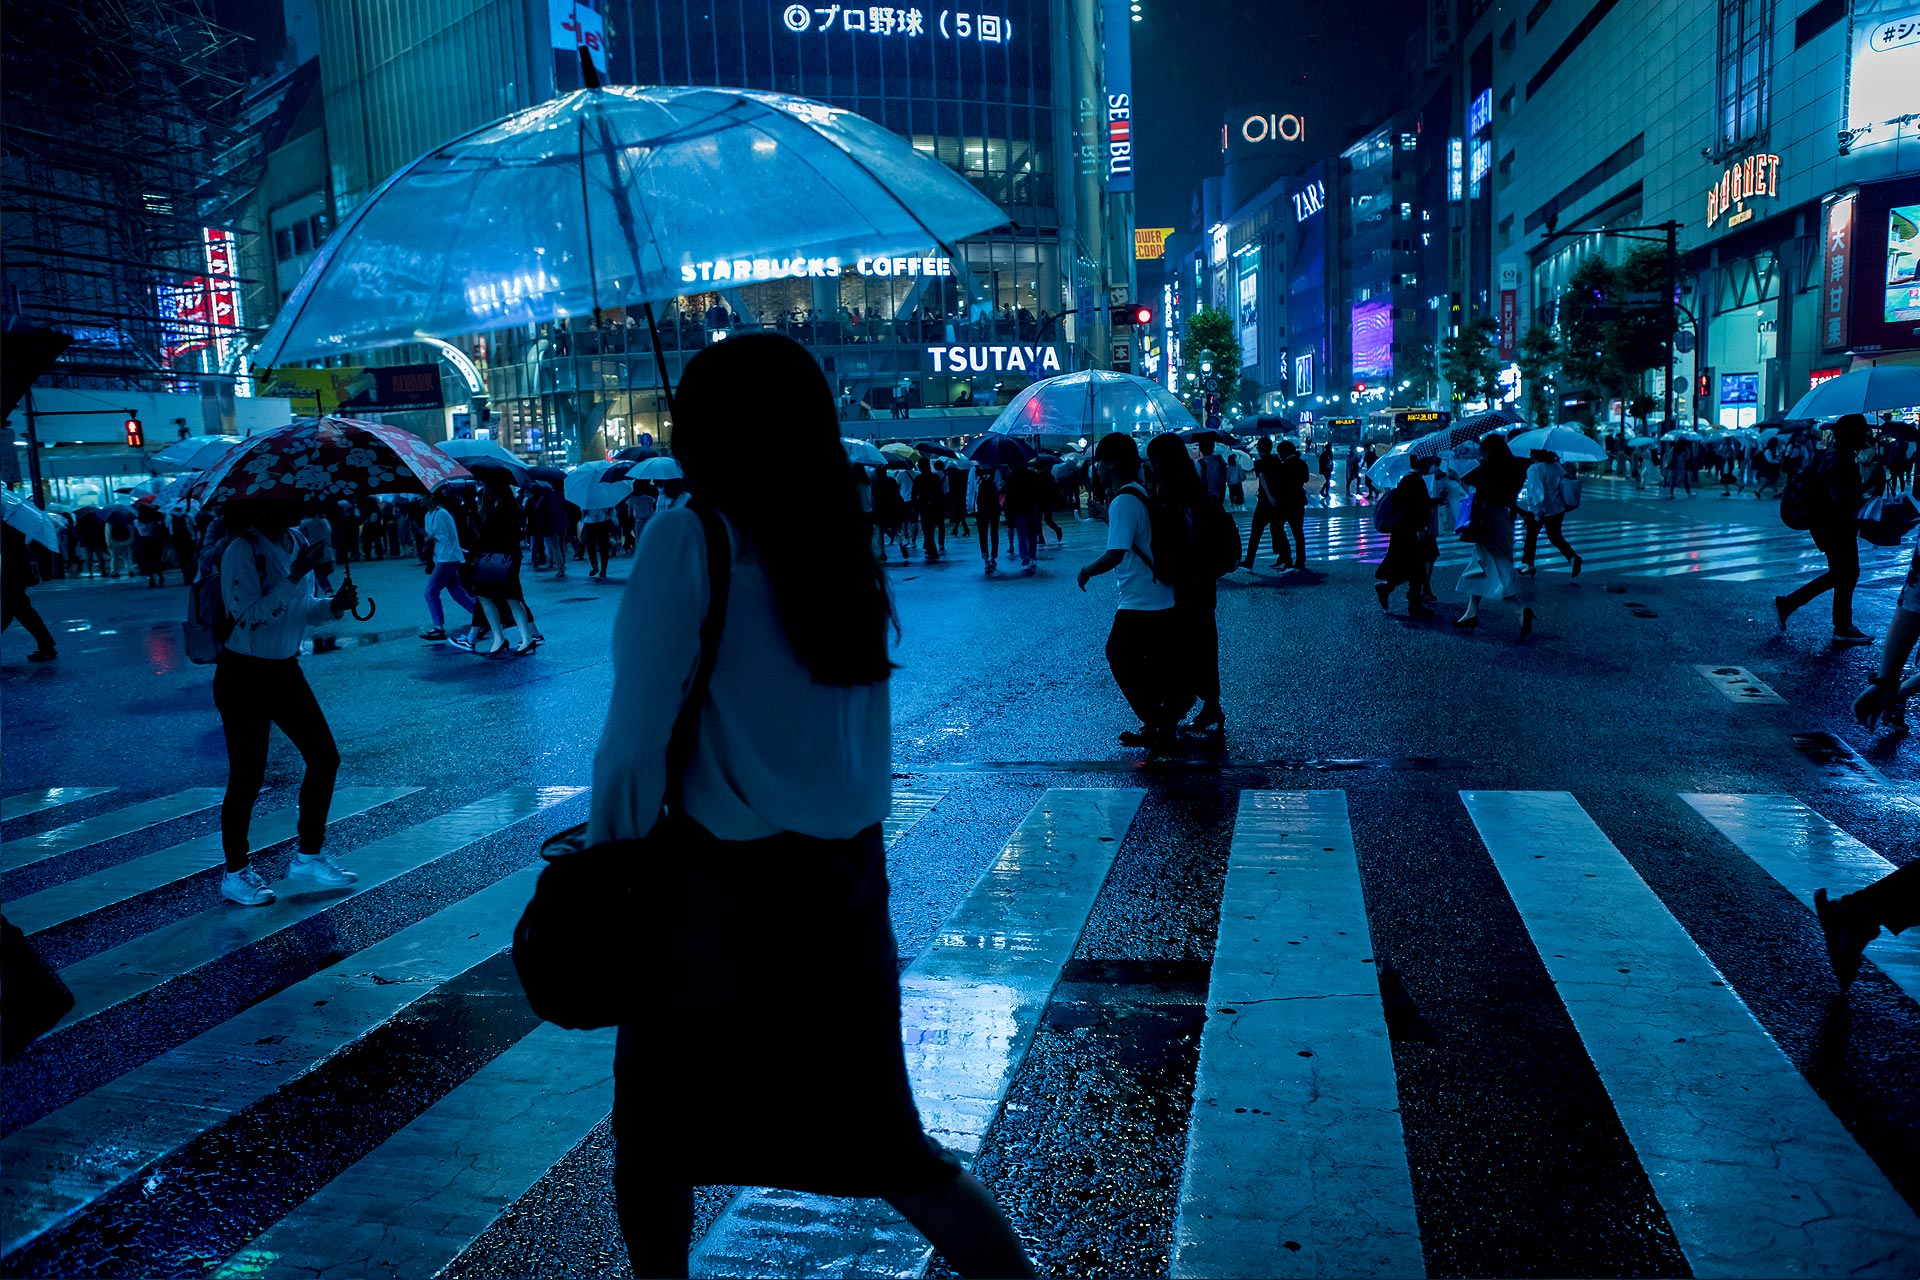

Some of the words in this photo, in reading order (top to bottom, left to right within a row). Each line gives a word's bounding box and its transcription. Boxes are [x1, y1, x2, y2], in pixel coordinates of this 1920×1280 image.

[1108, 93, 1132, 174] SEIBU
[1707, 153, 1780, 228] MAGNET
[1135, 230, 1162, 243] OWER
[1135, 244, 1165, 258] CORD
[681, 256, 841, 282] STARBUCKS
[857, 257, 952, 277] COFFEE
[928, 345, 1060, 373] TSUTAYA
[1115, 346, 1127, 359] 本
[1280, 351, 1288, 380] ZARA
